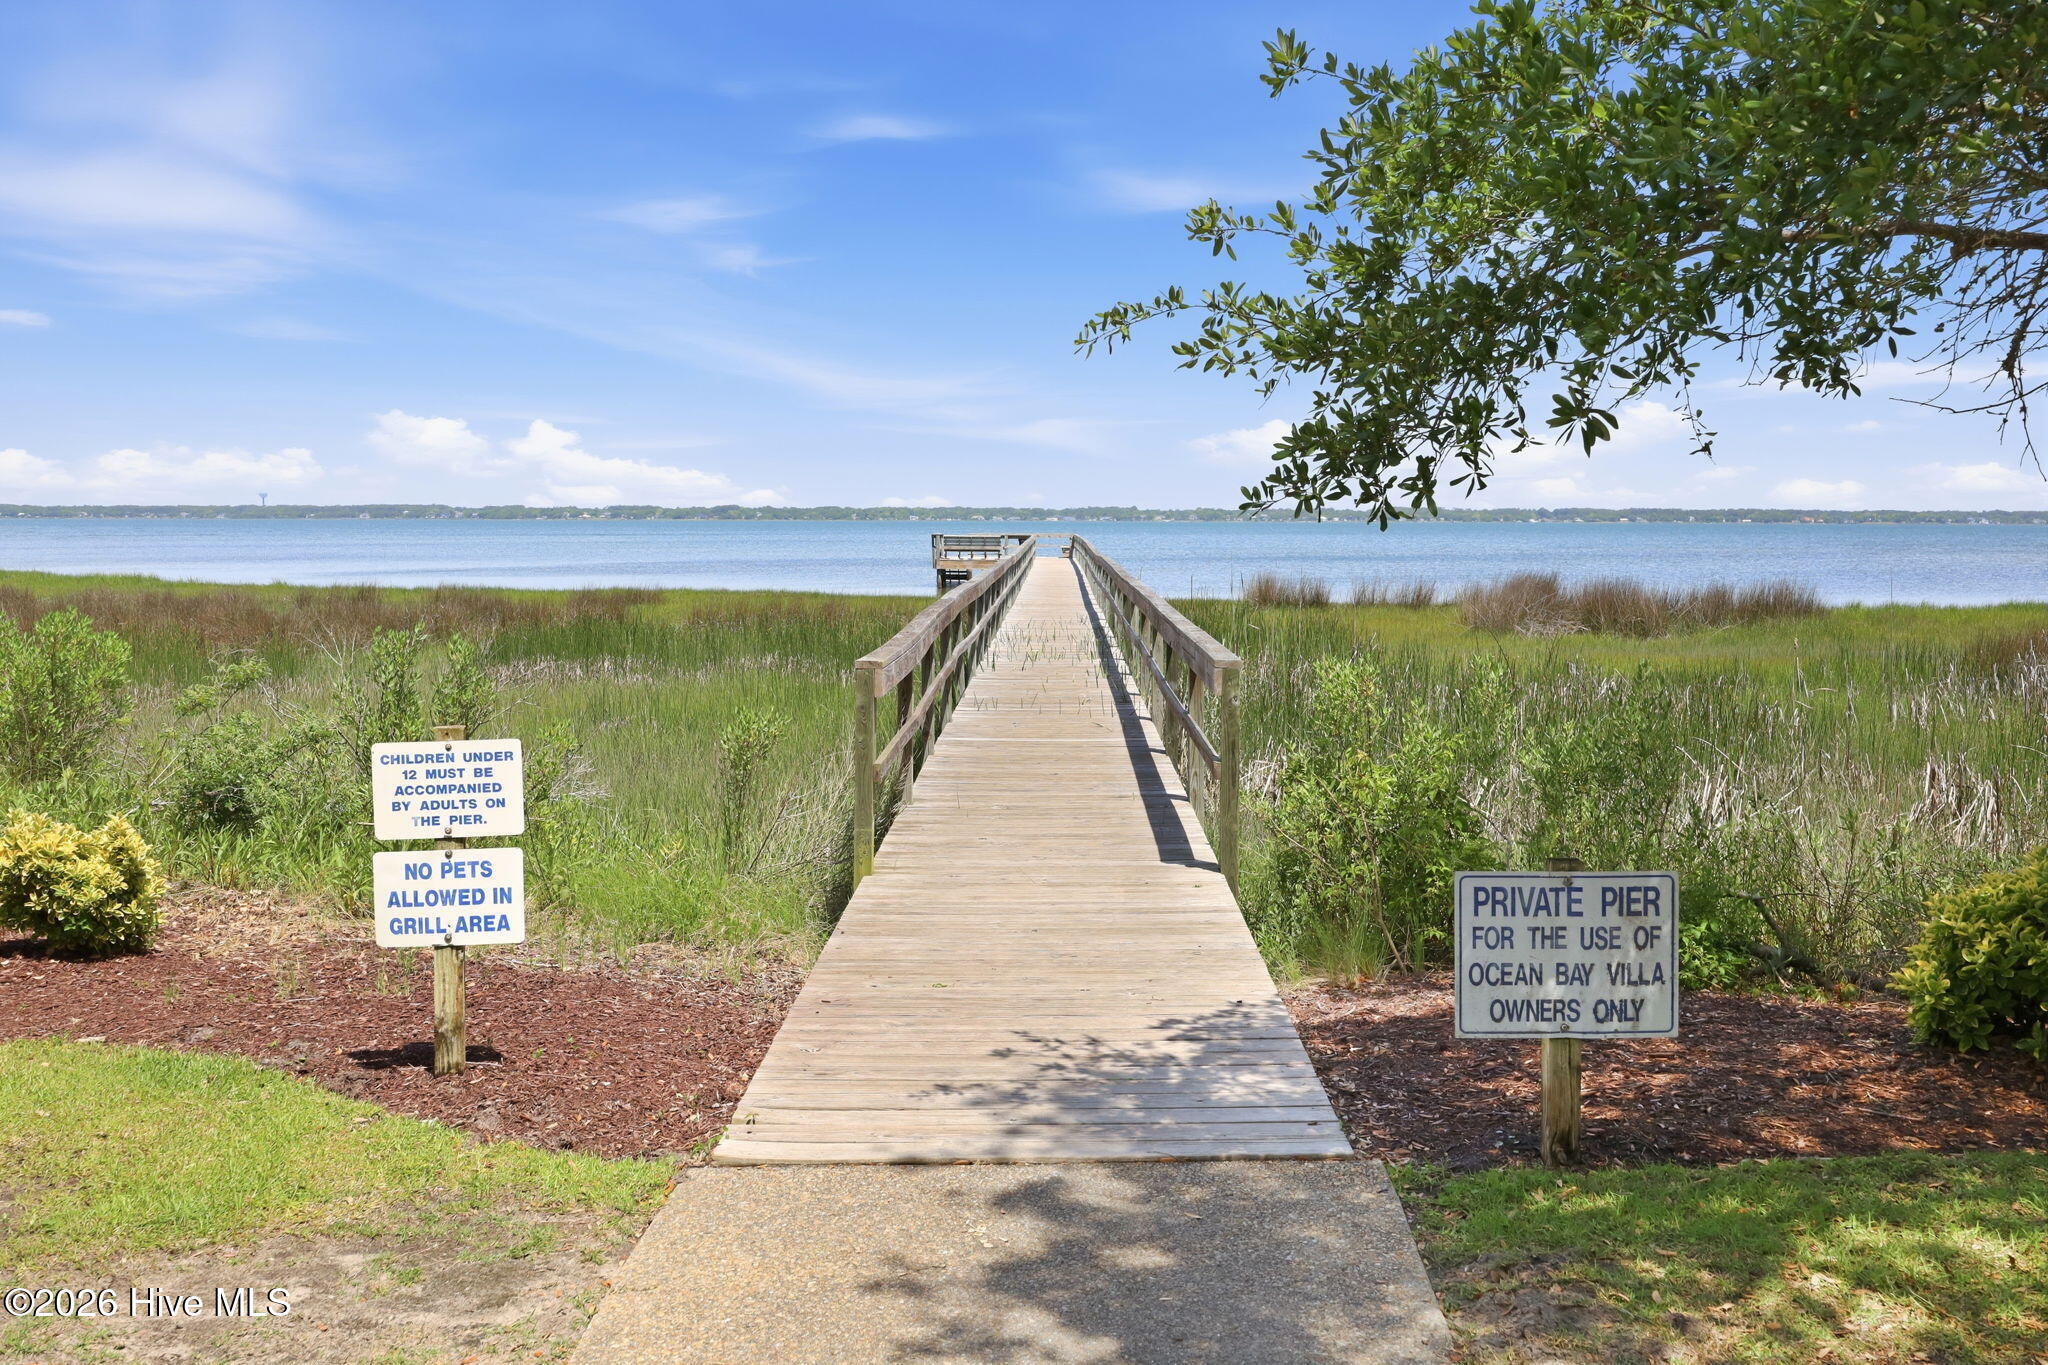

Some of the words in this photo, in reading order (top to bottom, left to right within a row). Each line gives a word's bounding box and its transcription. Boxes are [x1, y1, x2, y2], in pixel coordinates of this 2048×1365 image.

[380, 753, 455, 765] CHILDREN
[463, 751, 514, 762] UNDER
[402, 770, 417, 780] 12
[426, 768, 465, 779] MUST
[474, 767, 493, 778] BE
[395, 783, 502, 796] ACCOMPANIED
[392, 801, 411, 812] BY
[420, 799, 477, 811] ADULTS
[486, 798, 506, 808] ON
[412, 816, 440, 827] THE
[449, 815, 487, 825] PIER.
[405, 863, 432, 880] NO
[441, 861, 493, 879] PETS
[387, 888, 485, 908] ALLOWED
[493, 887, 512, 904] IN
[1473, 886, 1584, 917] PRIVATE
[1602, 886, 1661, 917] PIER
[390, 917, 447, 935] GRILL
[455, 915, 510, 933] AREA
[1472, 926, 1514, 950] FOR
[1528, 926, 1567, 949] THE
[1580, 926, 1621, 950] USE
[1634, 926, 1662, 951] OF
[1469, 963, 1543, 986] OCEAN
[1556, 963, 1594, 986] BAY
[1607, 962, 1665, 986] VILLA
[1490, 999, 1581, 1023] OWNERS
[1593, 998, 1644, 1023] ONLY
